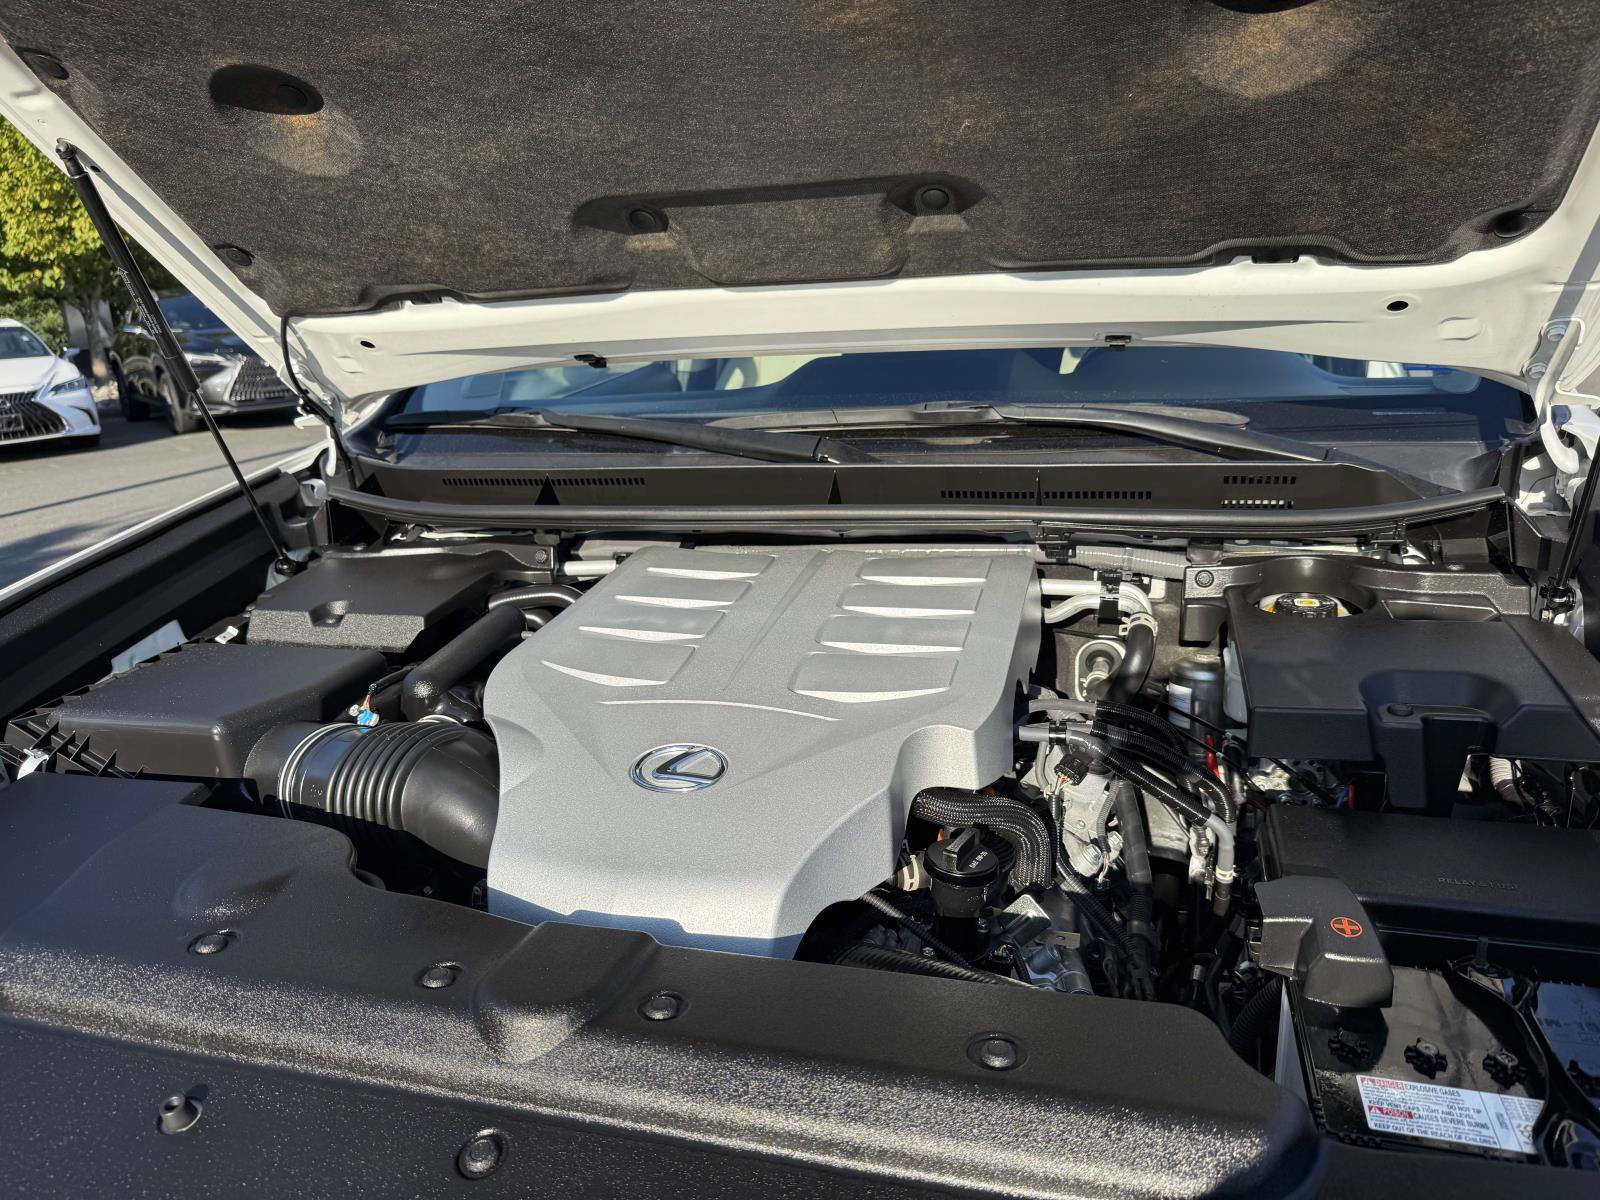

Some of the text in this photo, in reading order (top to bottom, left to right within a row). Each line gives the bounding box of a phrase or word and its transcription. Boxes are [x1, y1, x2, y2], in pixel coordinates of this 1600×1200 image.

[1375, 1079, 1404, 1090] DANGER
[1405, 1083, 1439, 1094] EXPLOSIVE
[1440, 1088, 1461, 1097] GASES
[1368, 1099, 1385, 1107] KEEP
[1422, 1106, 1440, 1114] TIGHT
[1383, 1109, 1409, 1118] POISON
[1413, 1113, 1439, 1122] CAUSES
[1440, 1117, 1465, 1126] SEVERE
[1467, 1120, 1490, 1129] BURNS
[1374, 1122, 1391, 1130] KEEP
[1464, 1135, 1498, 1146] CHILDREN
